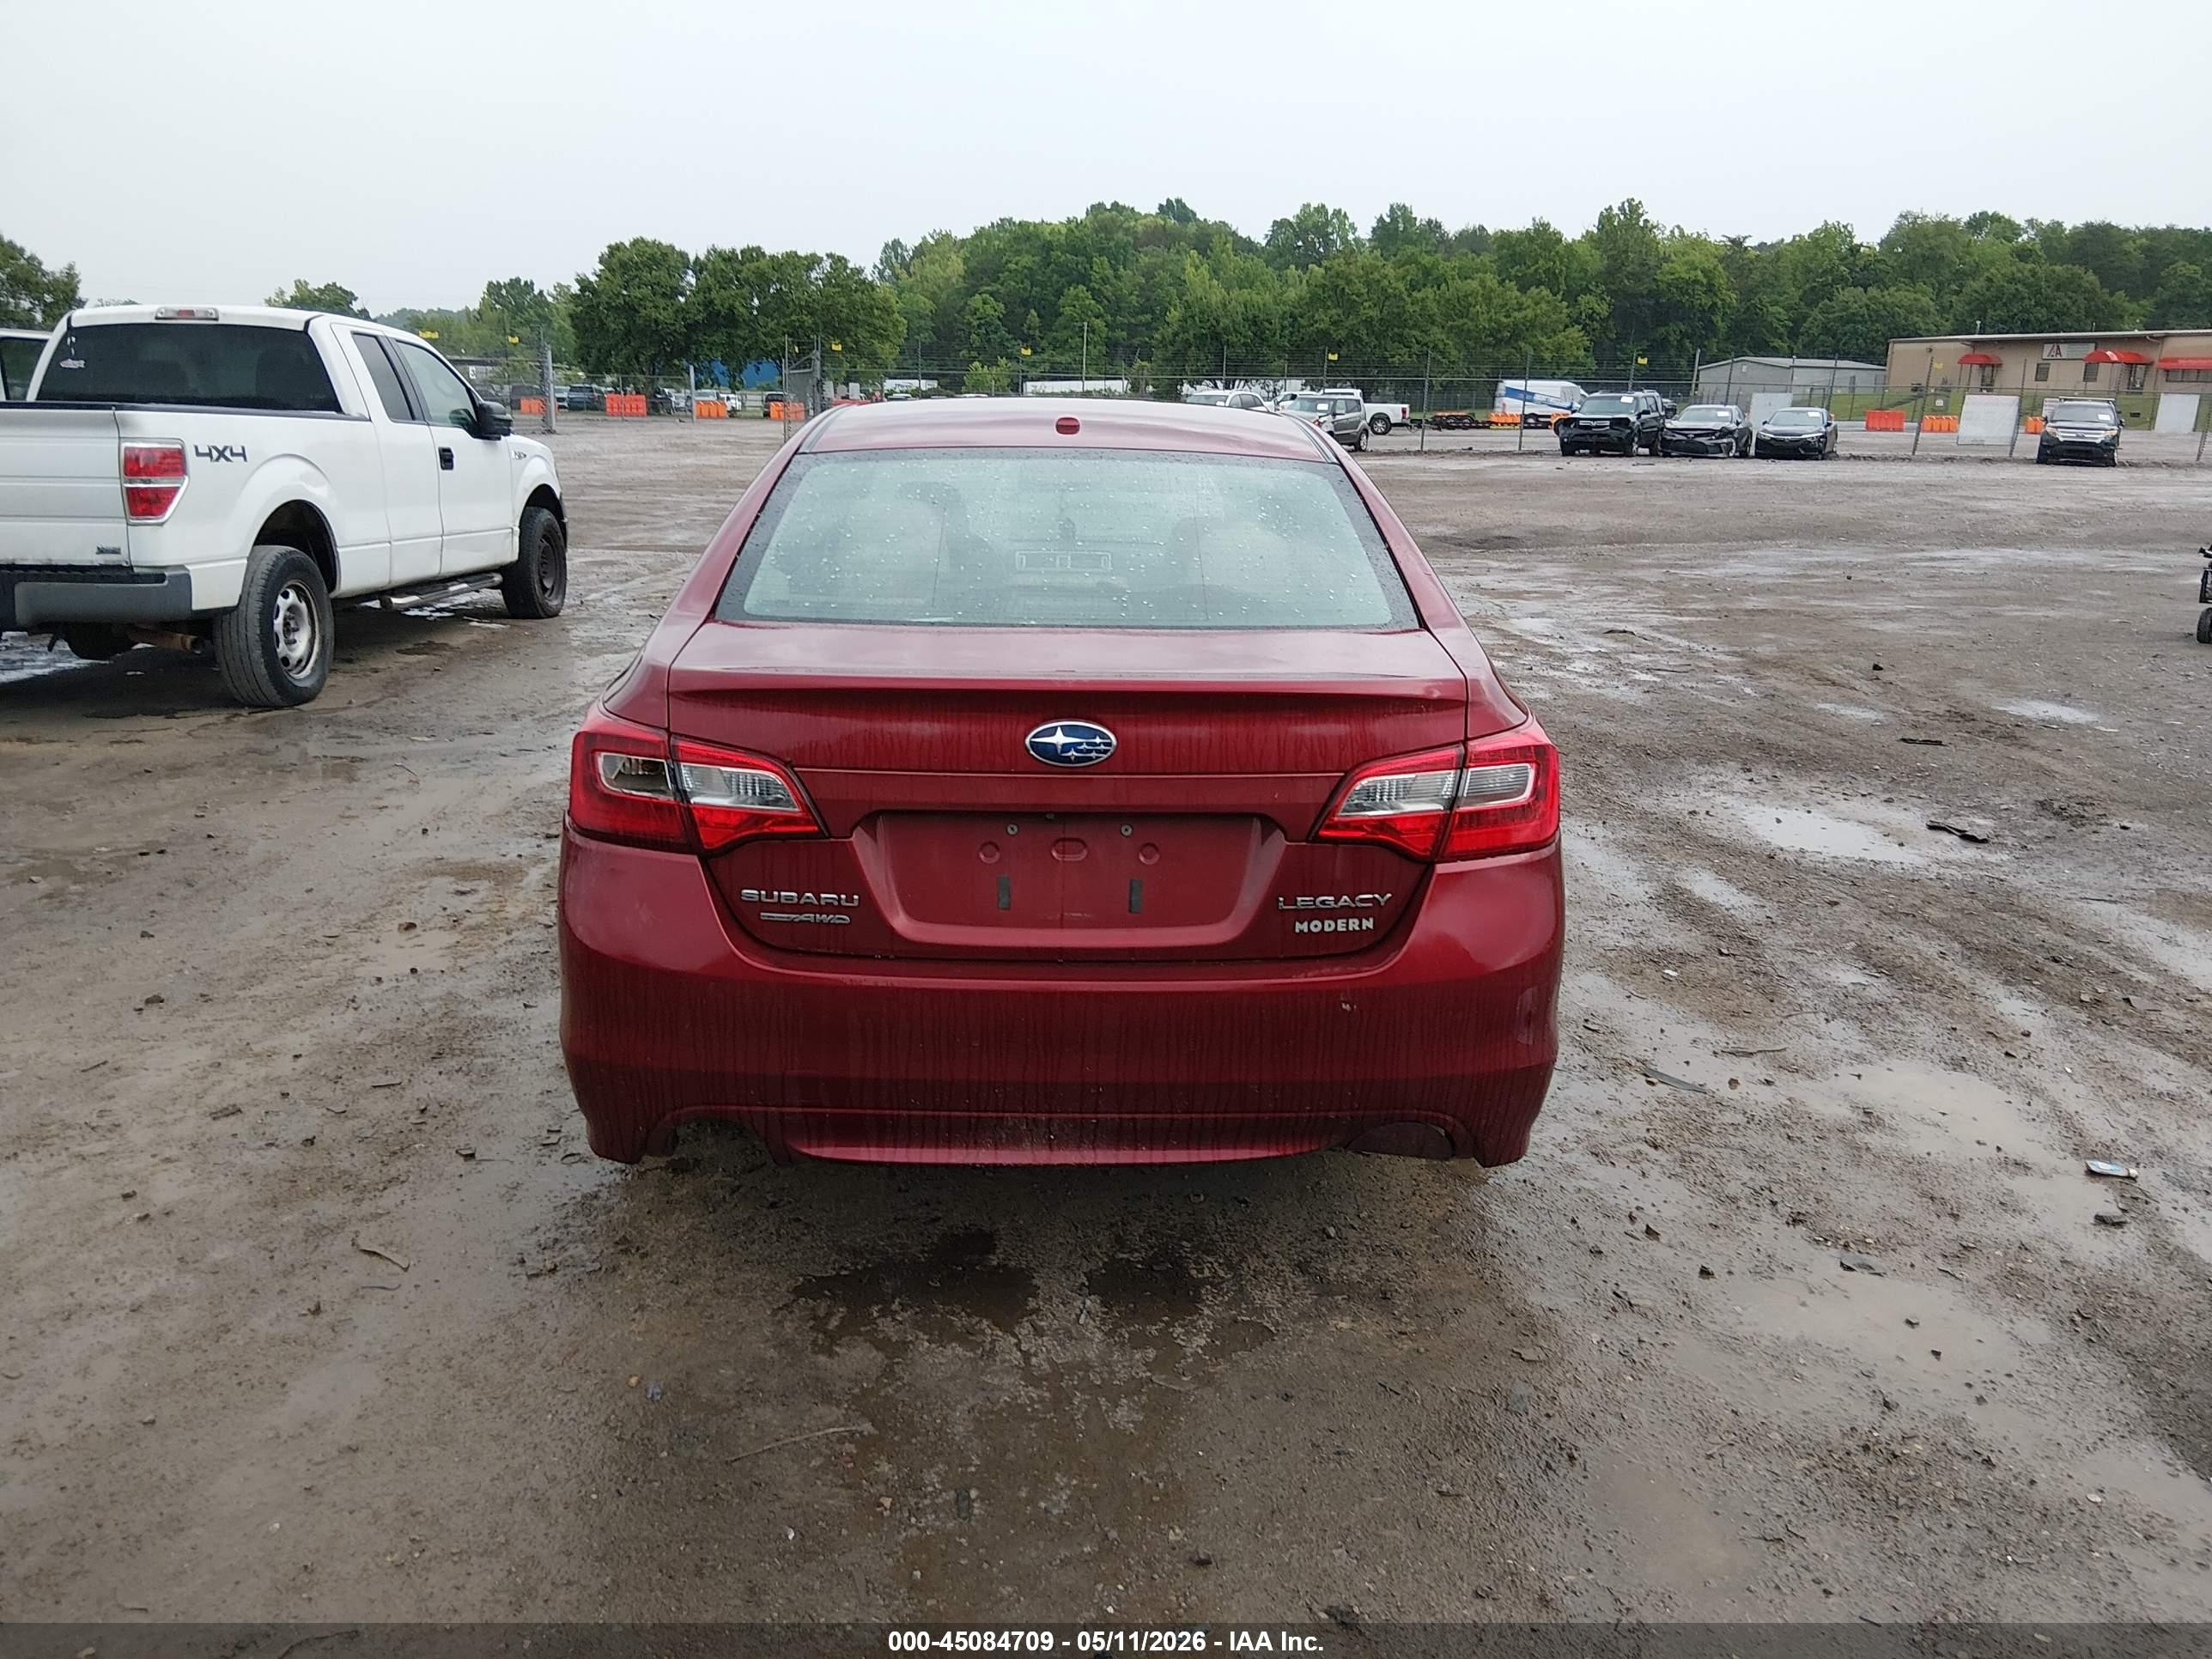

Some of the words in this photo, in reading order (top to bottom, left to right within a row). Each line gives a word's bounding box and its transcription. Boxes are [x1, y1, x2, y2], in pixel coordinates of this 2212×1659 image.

[193, 445, 247, 462] 4X4
[741, 889, 860, 907] SUBARU
[1278, 893, 1393, 910] LEGACY
[794, 913, 851, 925] AWD
[1294, 917, 1374, 933] MODERN
